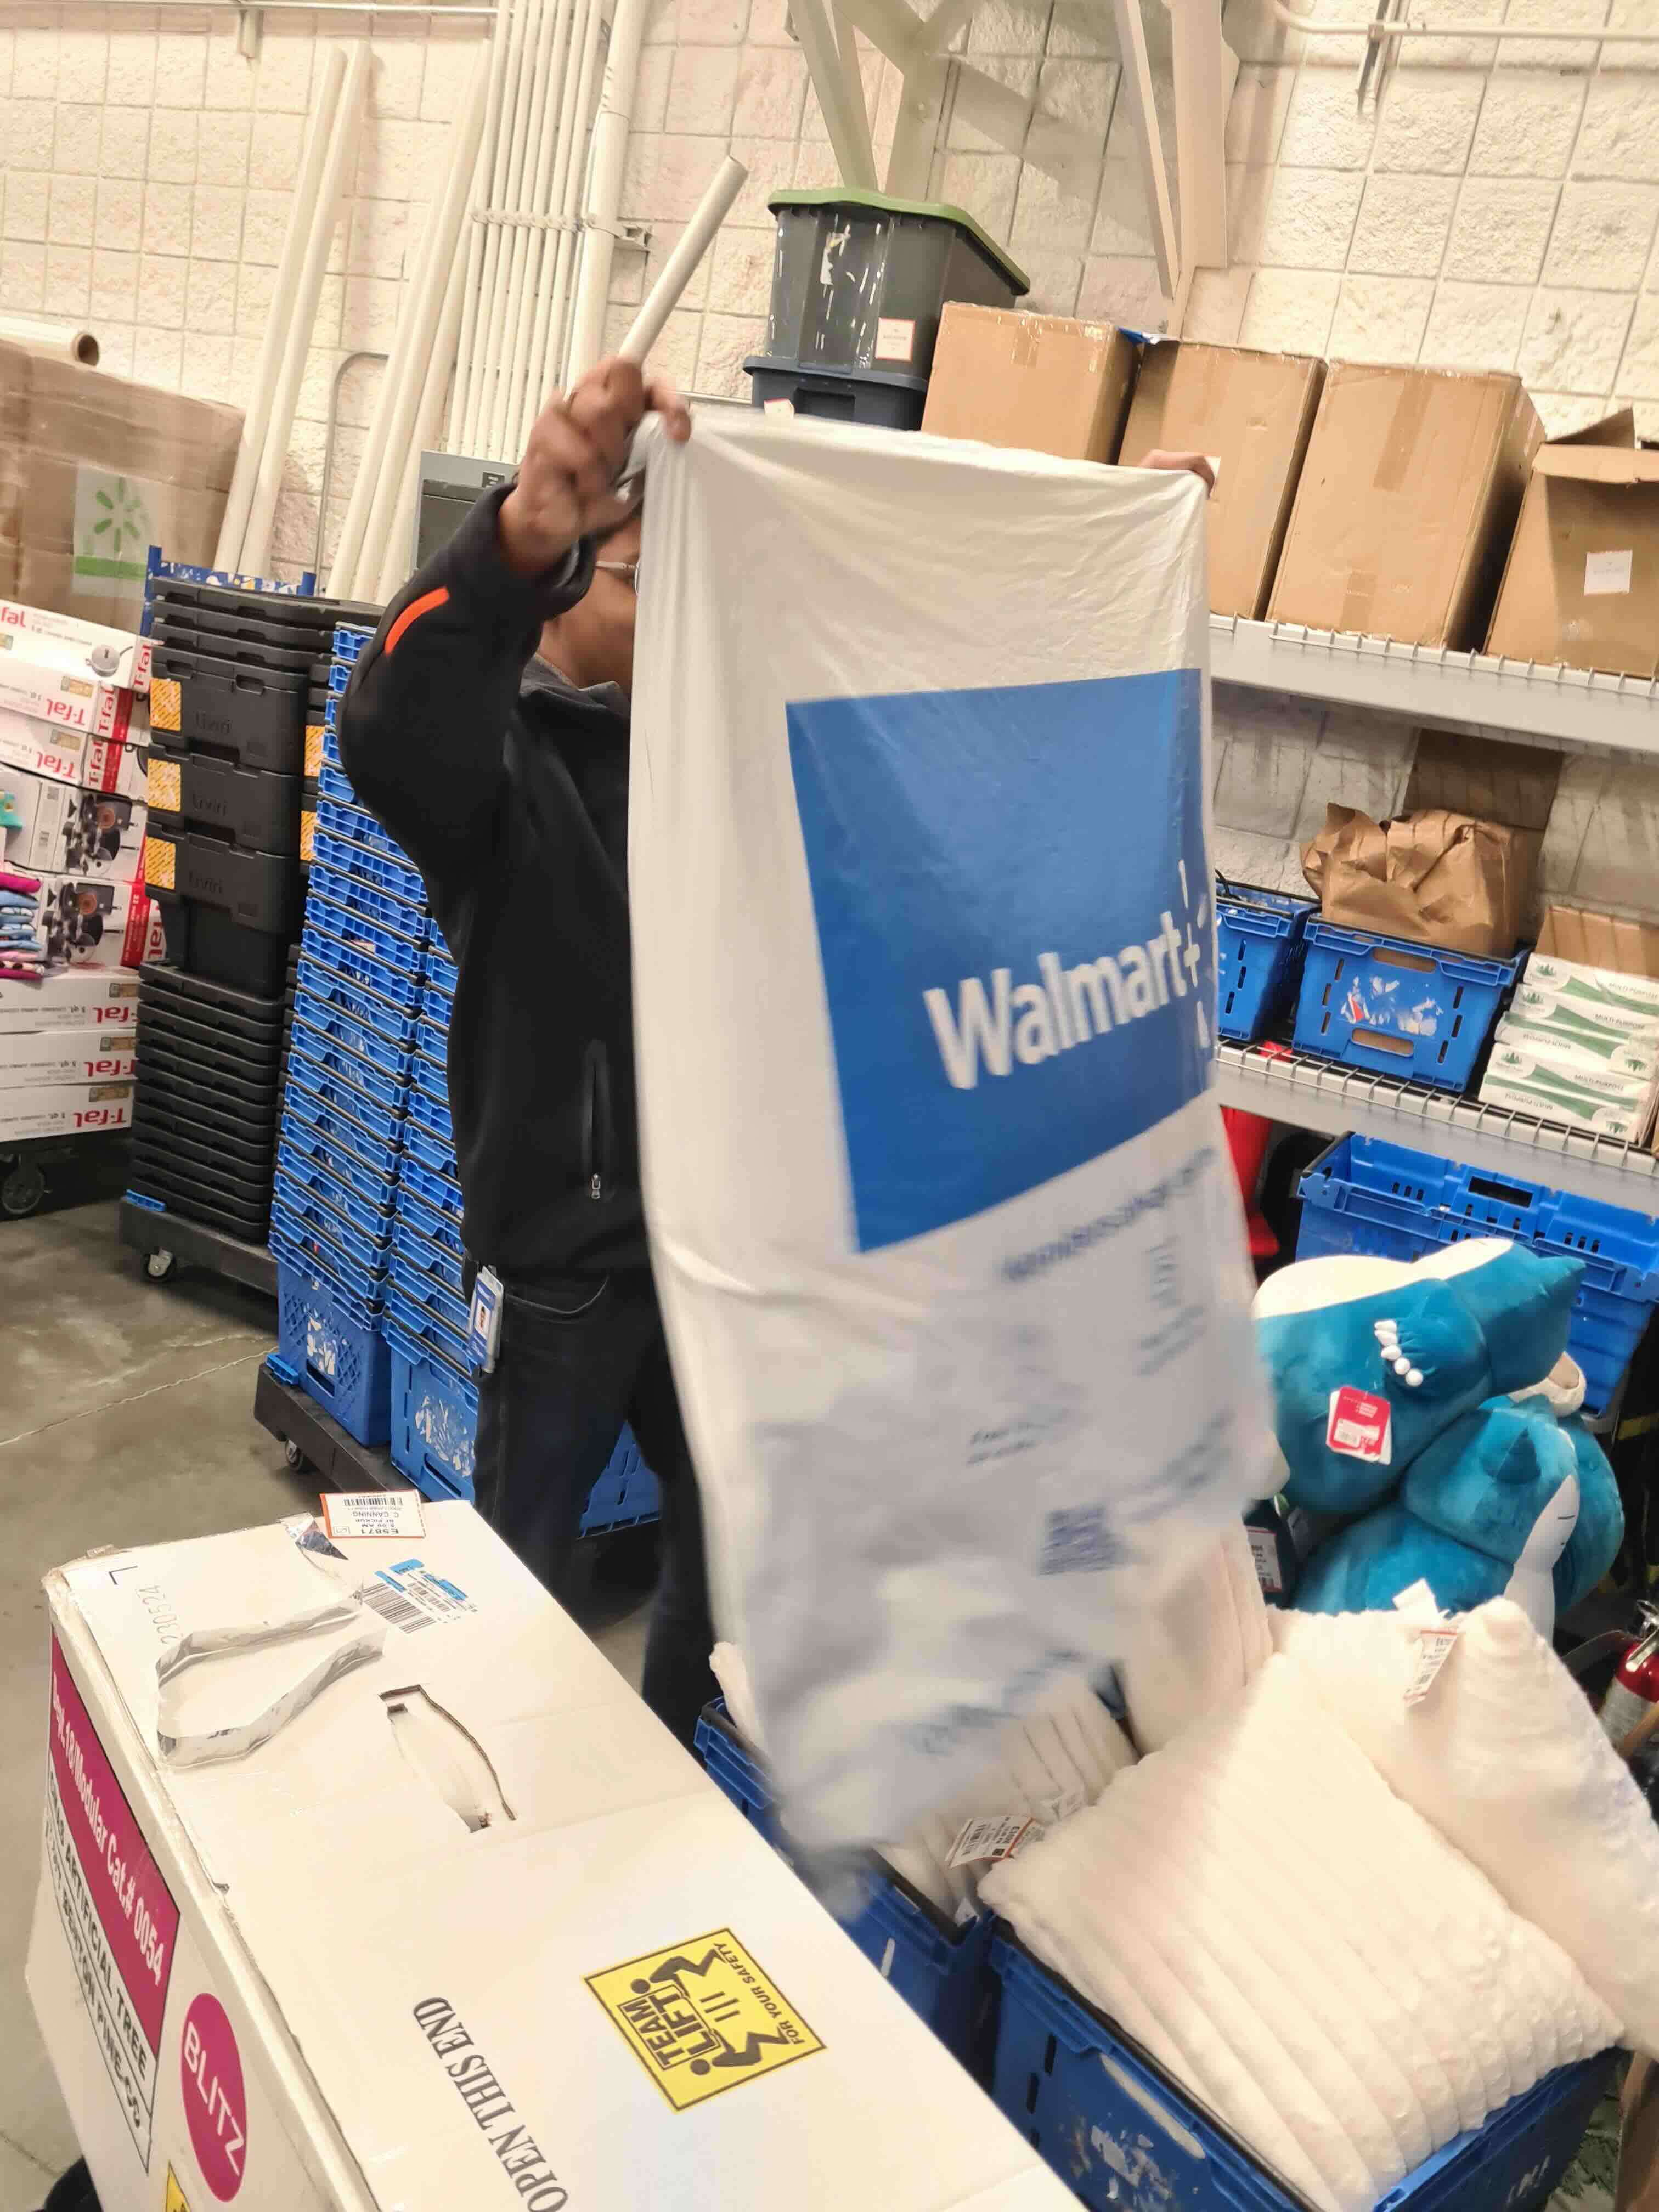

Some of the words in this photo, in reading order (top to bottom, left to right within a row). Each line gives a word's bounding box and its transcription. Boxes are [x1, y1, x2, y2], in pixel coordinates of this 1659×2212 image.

[922, 911, 1188, 1091] Walmart
[72, 1107, 127, 1128] T-fal
[134, 1897, 165, 1986] 0054
[714, 1943, 755, 1984] SAFETY
[117, 1987, 146, 2081] TREE
[413, 1996, 475, 2060] END
[623, 1999, 684, 2065] TEAM
[648, 1993, 716, 2055] LIFT
[751, 1986, 782, 2018] YOUR
[778, 2021, 805, 2044] FOR
[183, 2021, 245, 2176] BLITZ
[446, 2054, 512, 2130] THIS
[489, 2124, 569, 2212] OPEN
